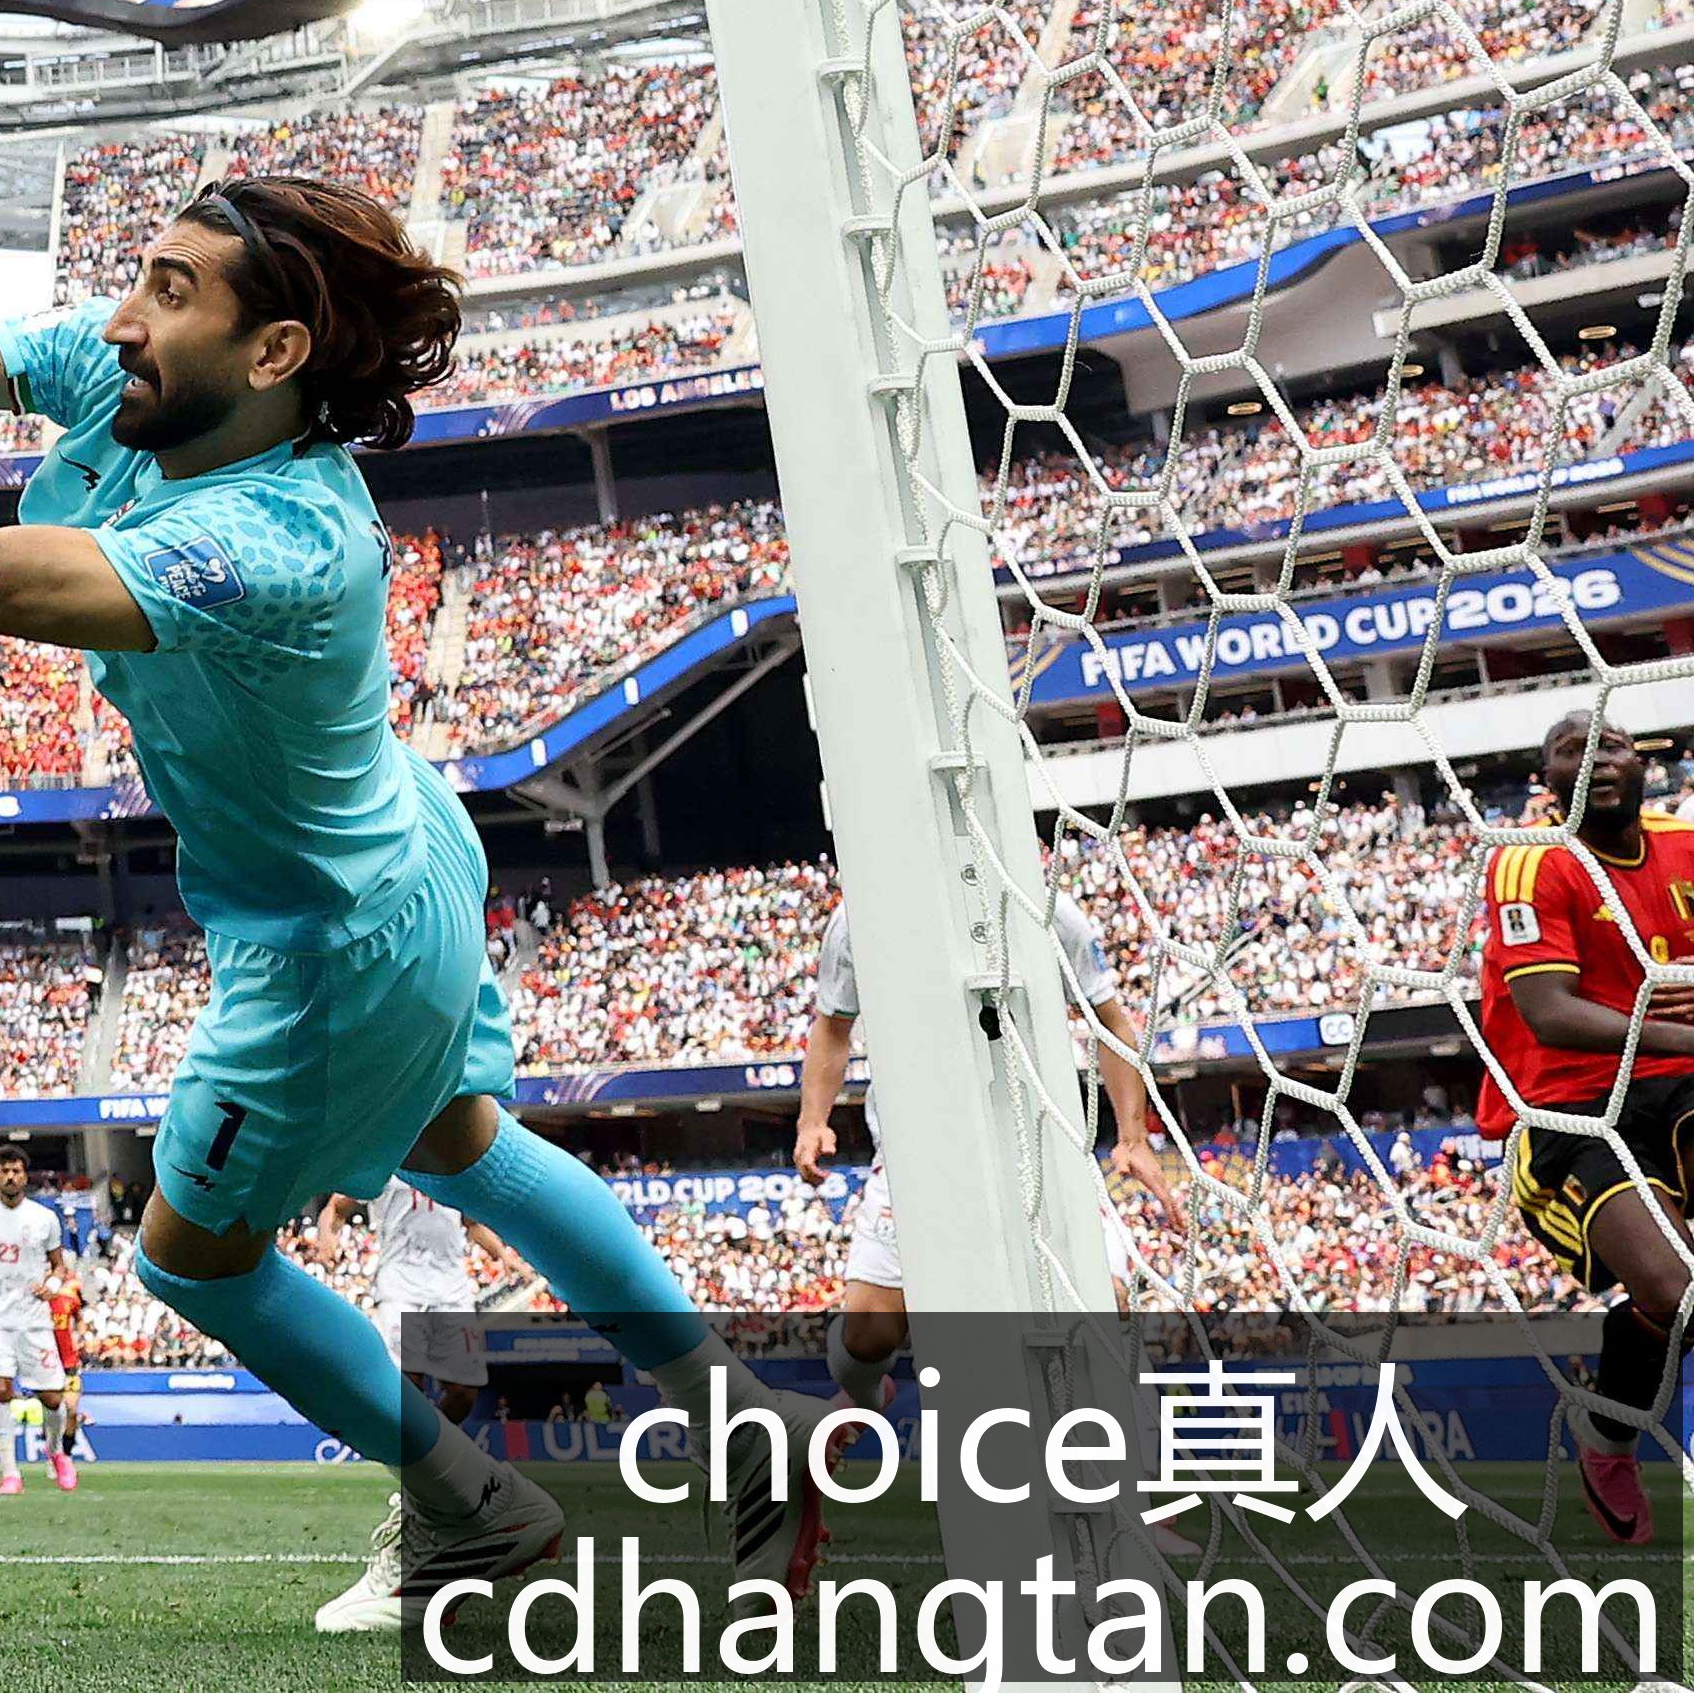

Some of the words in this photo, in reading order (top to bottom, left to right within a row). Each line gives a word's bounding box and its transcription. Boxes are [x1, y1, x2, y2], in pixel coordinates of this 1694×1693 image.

[1082, 641, 1176, 687] FIFA
[1175, 614, 1340, 672] WORLD
[1345, 596, 1436, 645] CUP
[1447, 568, 1622, 630] 2026
[745, 1065, 795, 1086] LOS
[206, 1102, 248, 1172] 1
[674, 1176, 736, 1205] CUP
